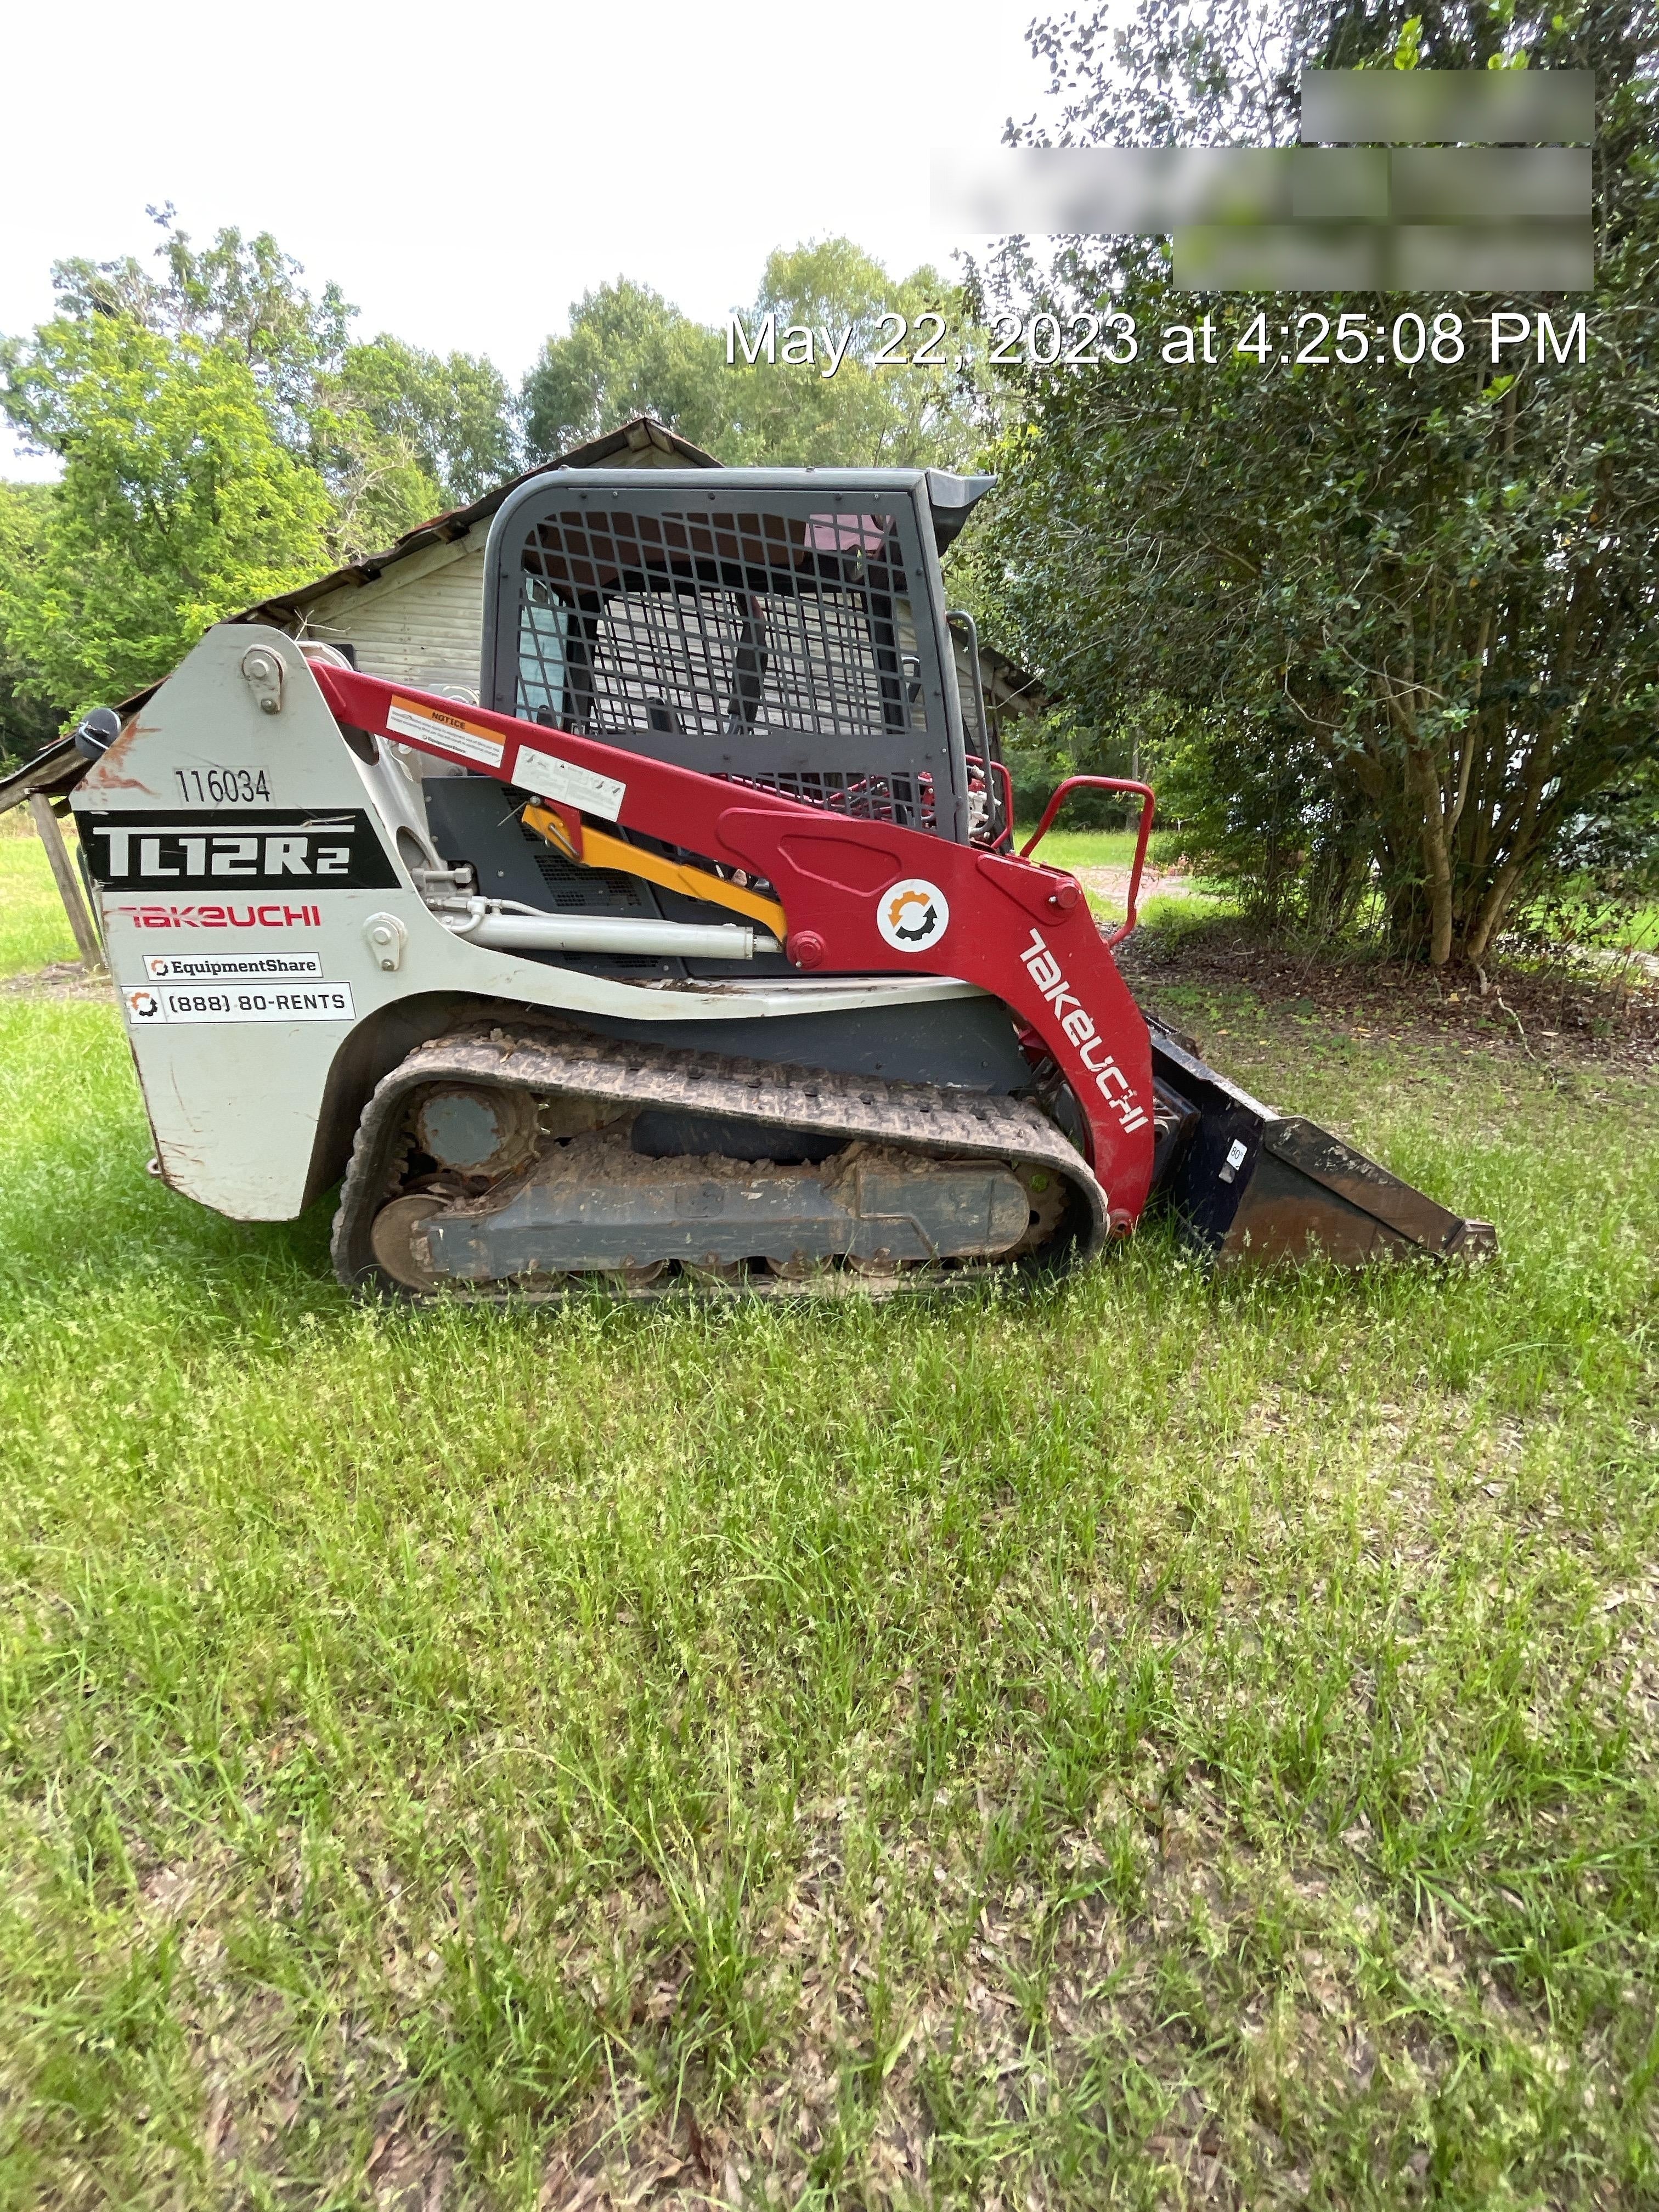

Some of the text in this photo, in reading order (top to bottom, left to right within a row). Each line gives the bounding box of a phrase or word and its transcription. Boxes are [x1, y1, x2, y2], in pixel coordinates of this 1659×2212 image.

[431, 712, 466, 730] NOTICE
[176, 770, 270, 802] 116034
[171, 959, 317, 976] EquipmentShare
[169, 994, 345, 1013] (888) 80-RENTS
